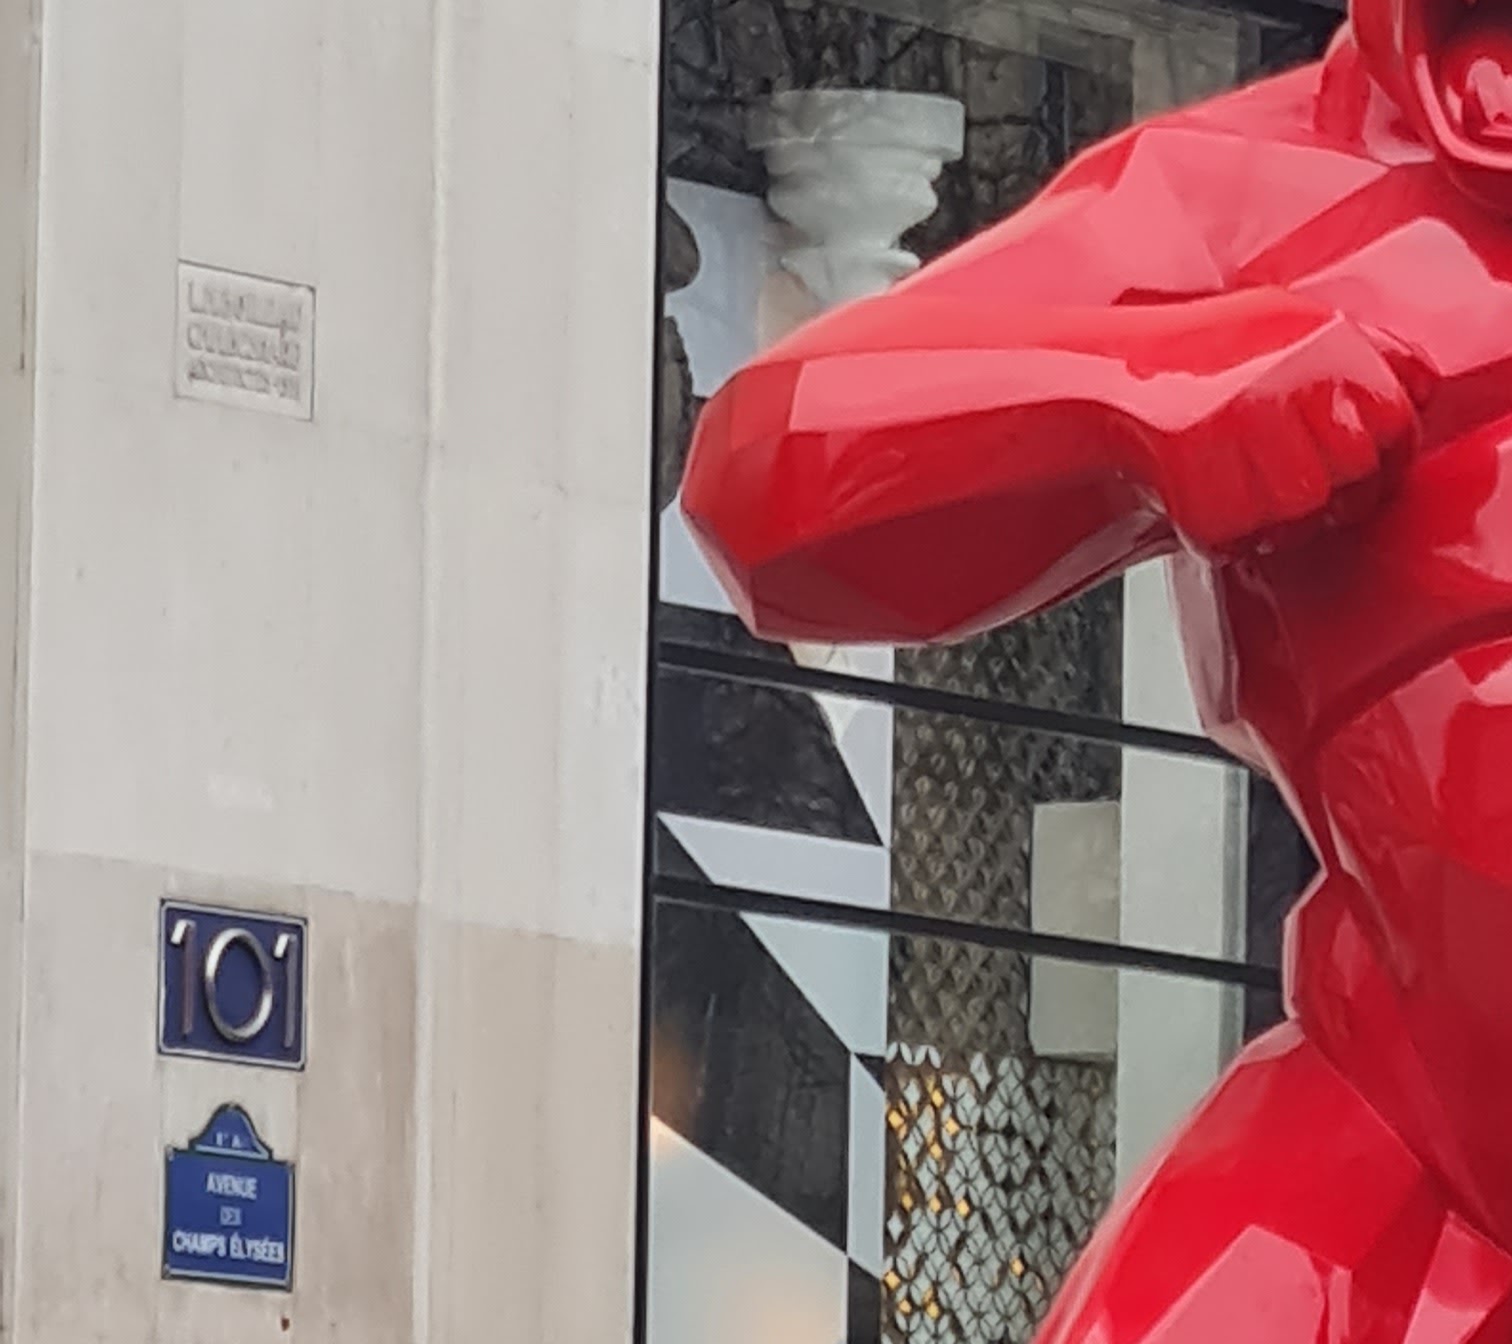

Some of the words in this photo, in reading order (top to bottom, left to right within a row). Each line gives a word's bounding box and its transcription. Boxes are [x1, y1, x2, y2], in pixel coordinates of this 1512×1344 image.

[170, 918, 298, 1049] 101
[206, 1171, 258, 1201] AVENUE
[172, 1229, 227, 1258] CHAMPS
